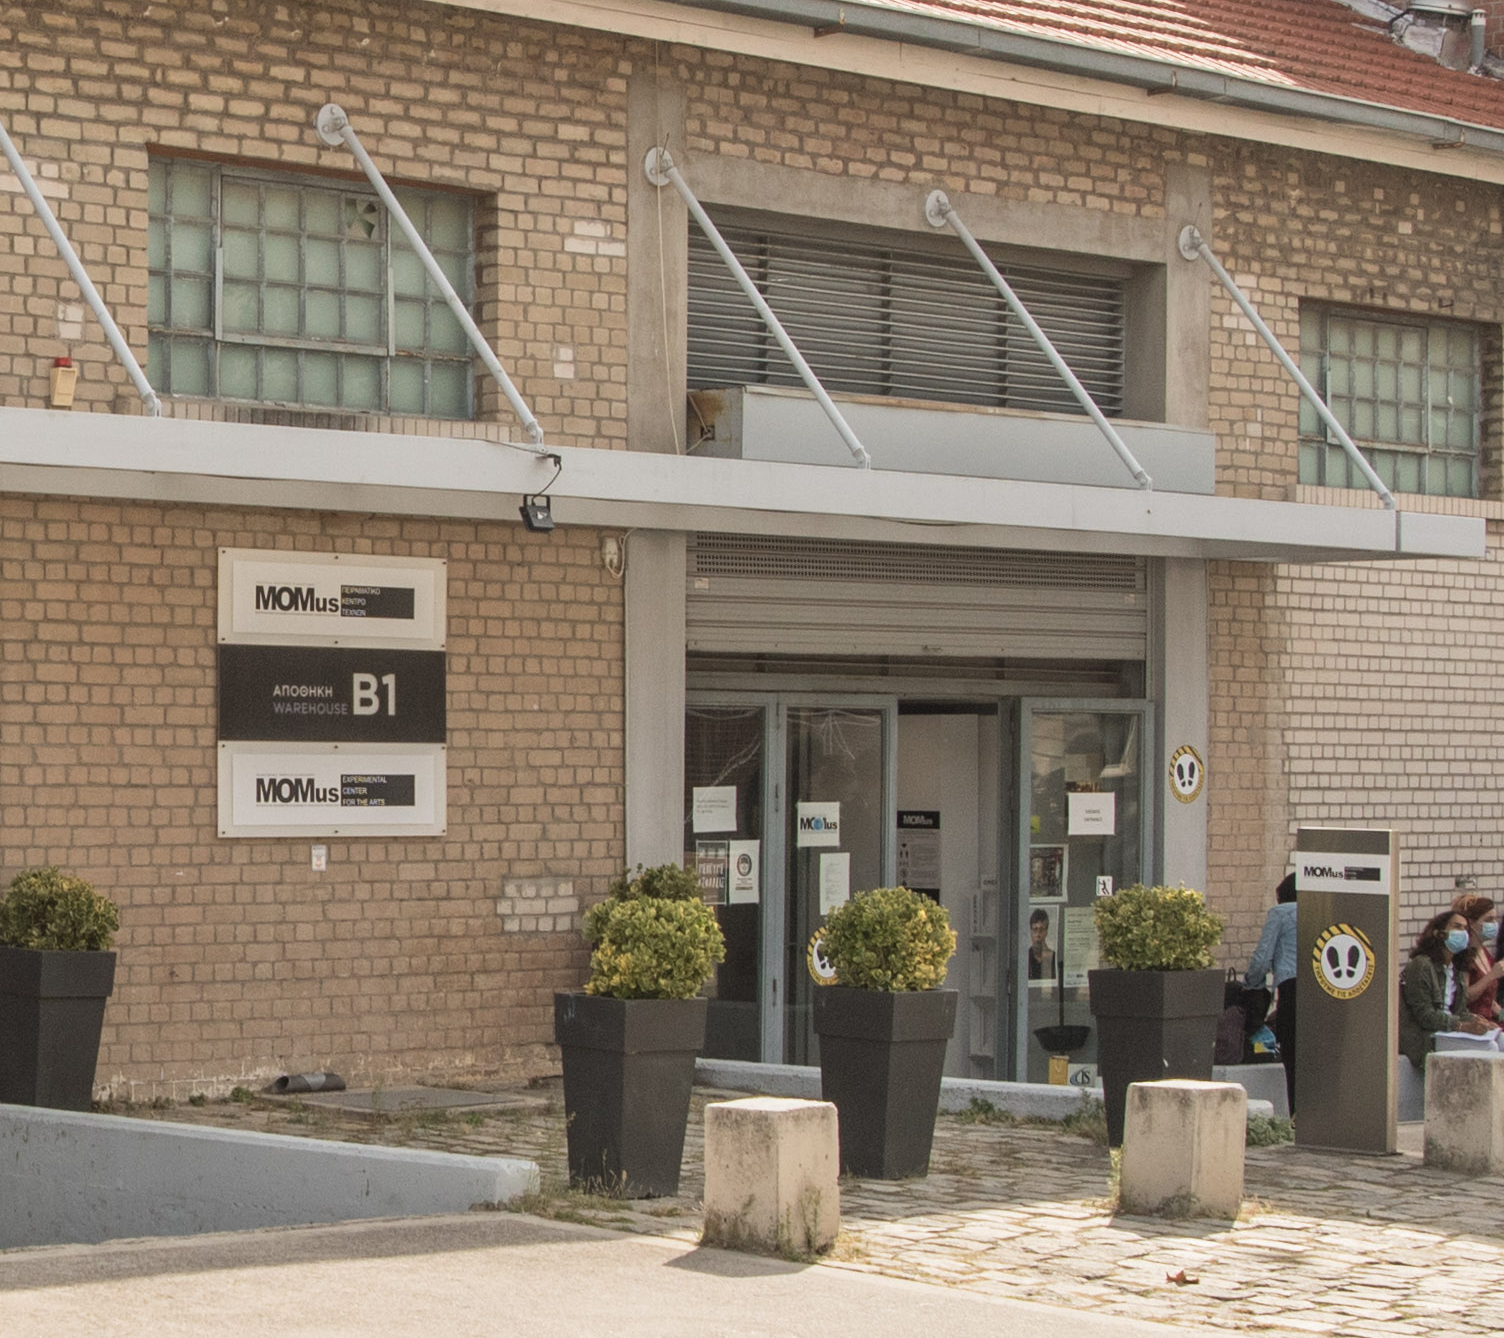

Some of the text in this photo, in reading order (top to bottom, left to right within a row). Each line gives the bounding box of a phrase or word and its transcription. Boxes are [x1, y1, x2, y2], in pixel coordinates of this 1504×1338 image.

[255, 585, 340, 613] MOMus
[273, 683, 334, 699] ΑΠΟΘΗΚΗ
[352, 672, 397, 717] B1
[273, 700, 349, 716] WAREHOUSE
[342, 776, 388, 784] EXPERIMENTAL
[255, 777, 340, 804] MOMus
[342, 787, 368, 795] CENTER
[369, 798, 386, 806] ARTS
[1303, 865, 1344, 879] MOMus
